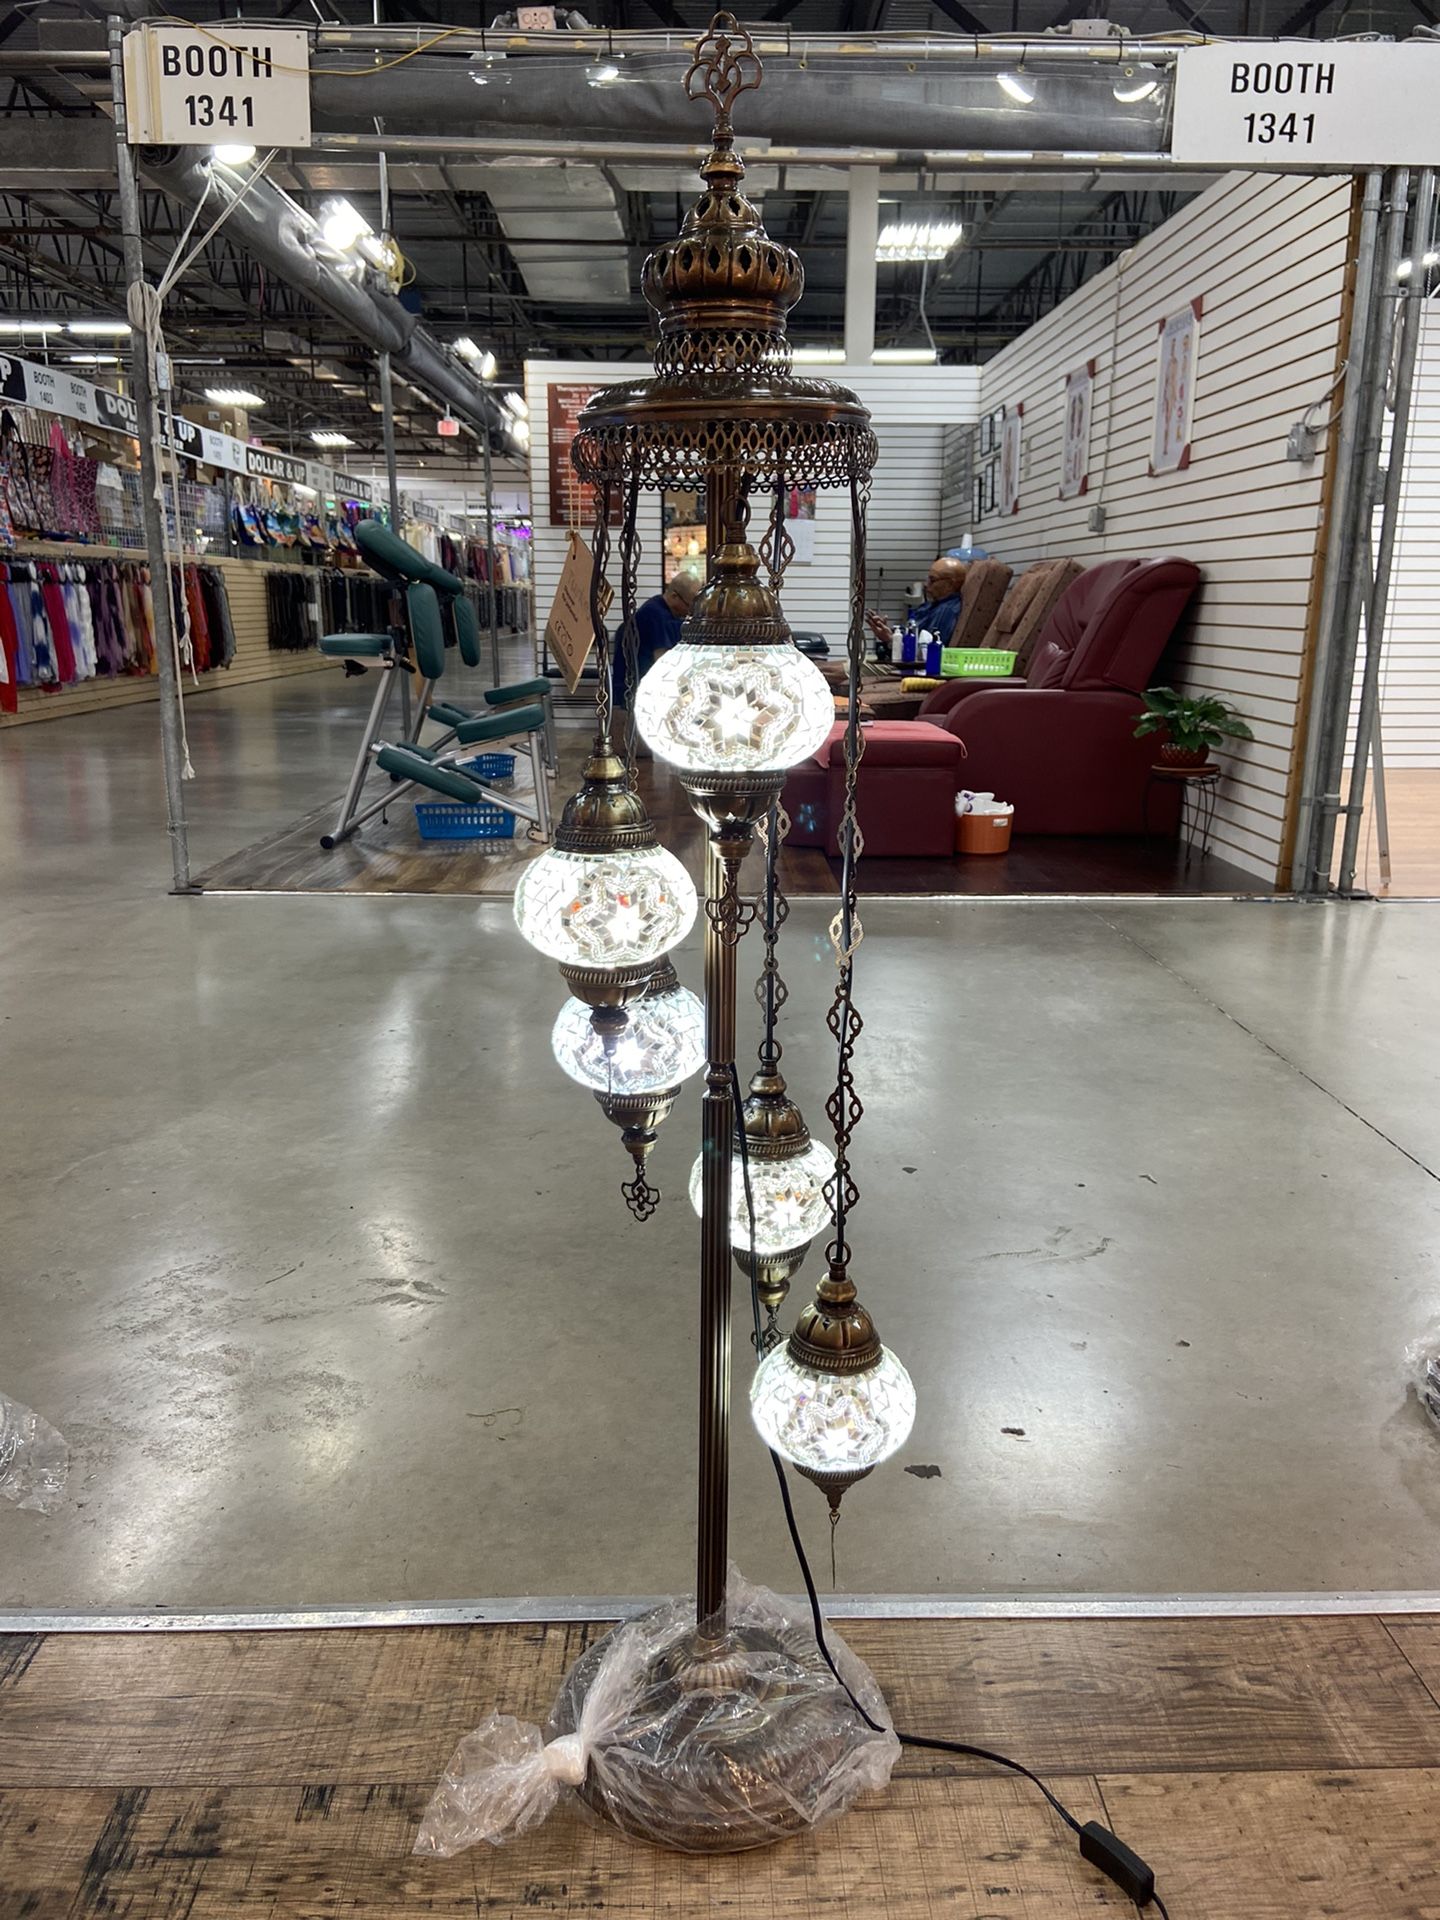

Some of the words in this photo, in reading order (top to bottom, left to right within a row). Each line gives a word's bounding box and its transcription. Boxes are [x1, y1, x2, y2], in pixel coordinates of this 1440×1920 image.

[162, 45, 272, 78] BOOTH
[1231, 62, 1335, 94] BOOTH
[185, 94, 254, 127] 1341
[1243, 112, 1315, 144] 1341
[33, 371, 55, 388] BOOTH
[178, 421, 196, 443] UP
[248, 452, 285, 477] DOLLAR
[286, 464, 294, 479] &
[294, 465, 306, 484] UP
